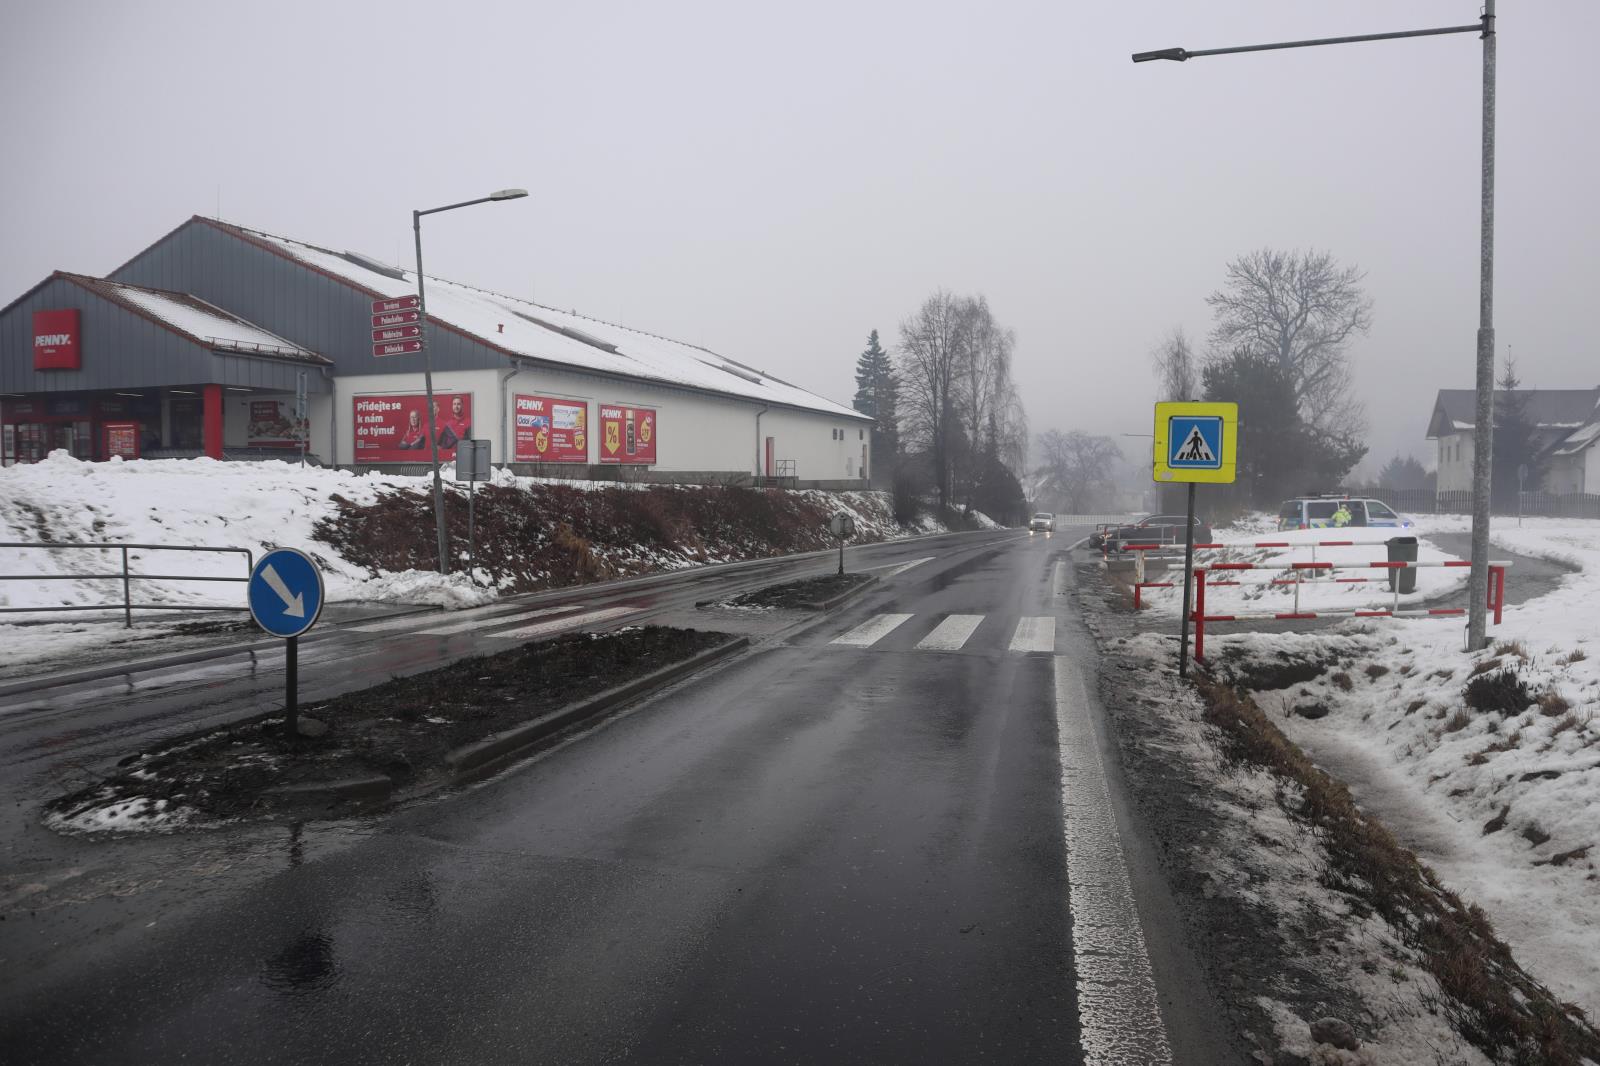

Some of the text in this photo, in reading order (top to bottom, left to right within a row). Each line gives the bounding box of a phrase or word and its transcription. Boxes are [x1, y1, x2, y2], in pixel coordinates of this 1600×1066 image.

[358, 400, 392, 412] Přidejte
[358, 413, 384, 423] k nám
[358, 425, 394, 436] do týmu!
